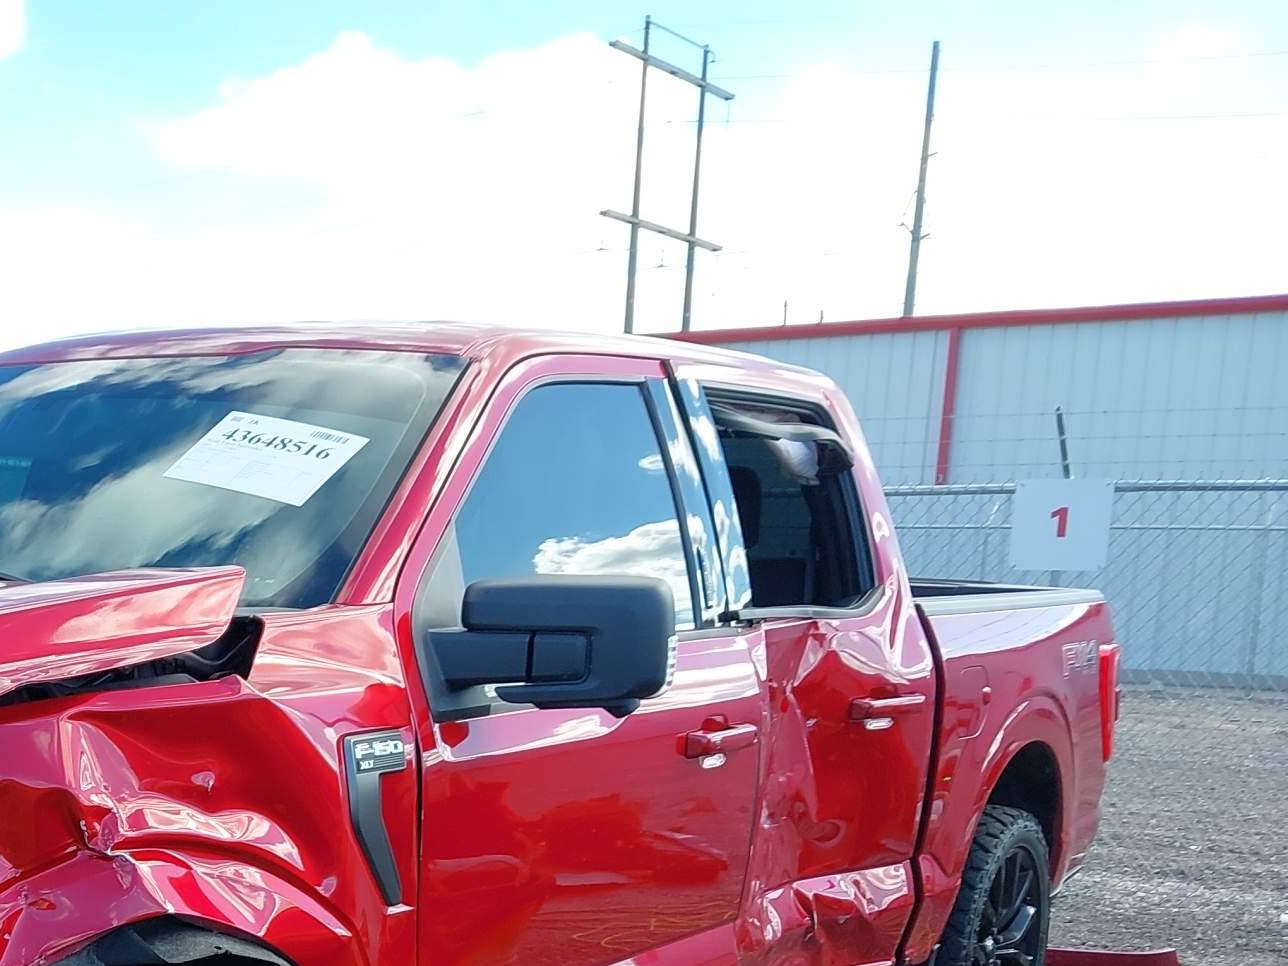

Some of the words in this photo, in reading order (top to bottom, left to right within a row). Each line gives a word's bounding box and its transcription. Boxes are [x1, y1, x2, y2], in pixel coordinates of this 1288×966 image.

[222, 428, 336, 460] 43648516
[1050, 506, 1069, 538] 1
[355, 740, 404, 759] F-150
